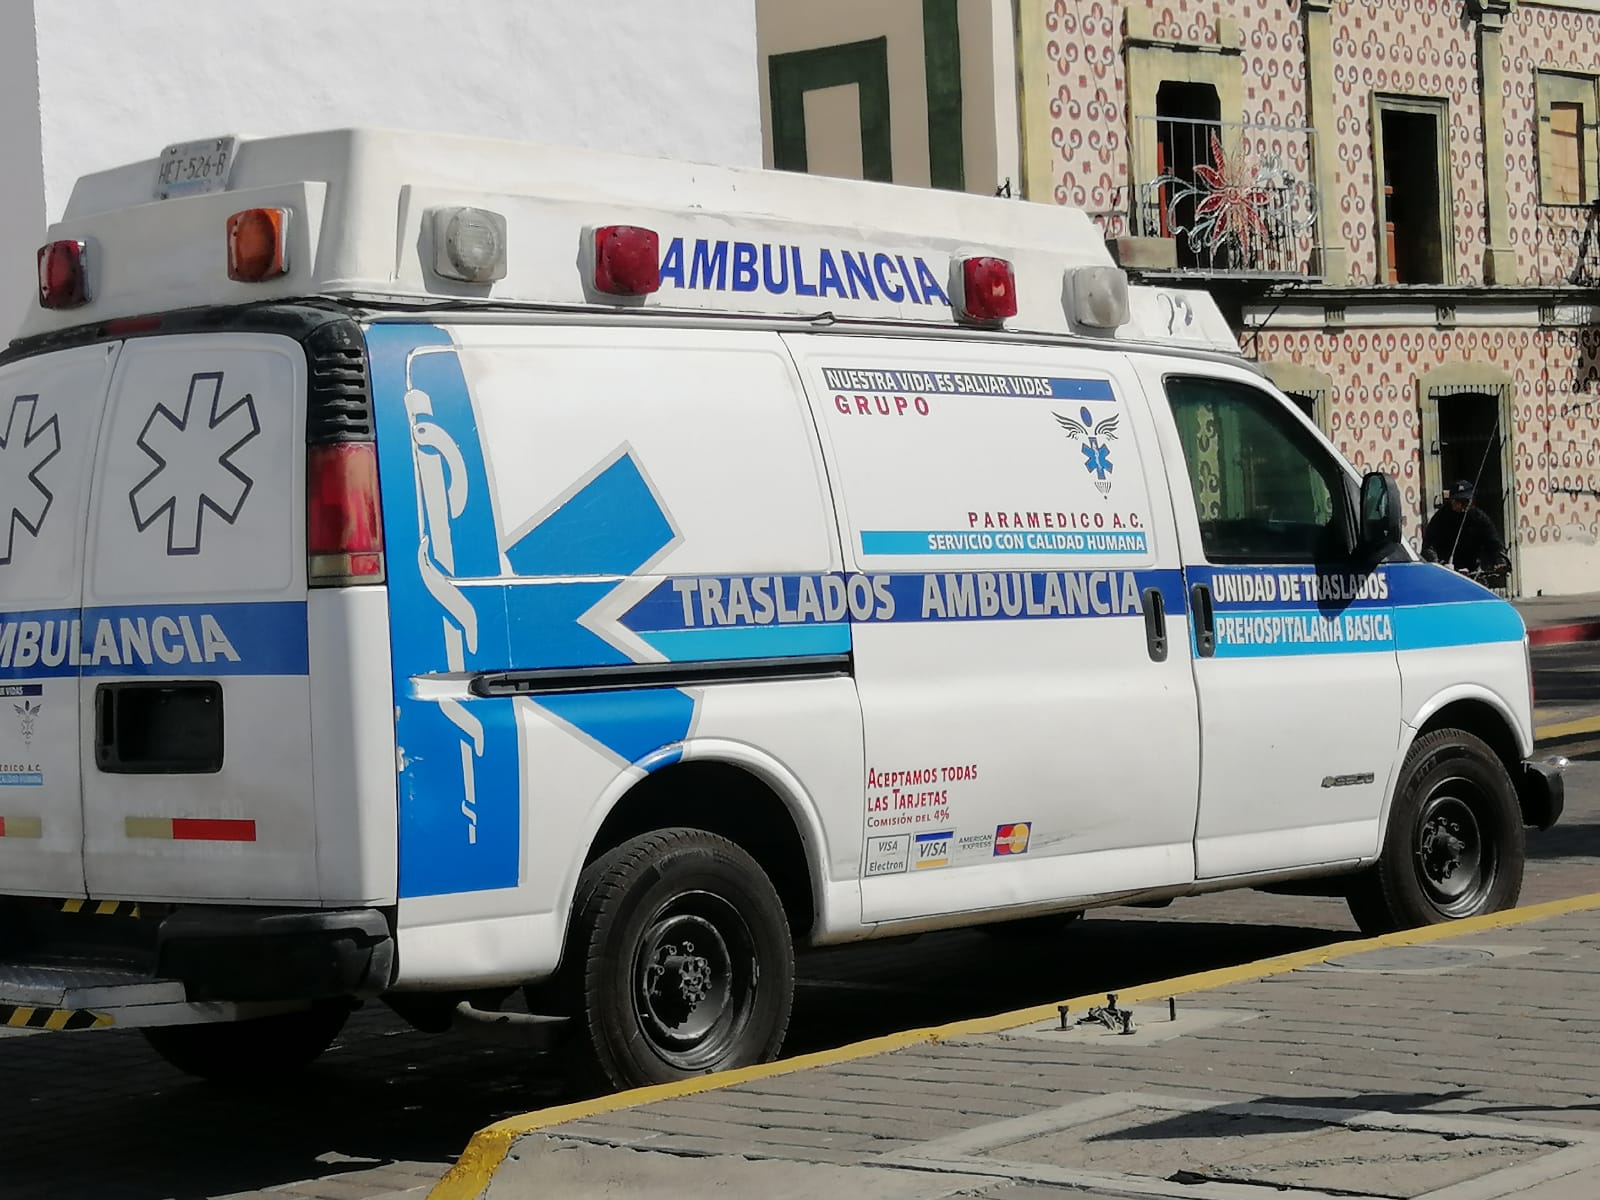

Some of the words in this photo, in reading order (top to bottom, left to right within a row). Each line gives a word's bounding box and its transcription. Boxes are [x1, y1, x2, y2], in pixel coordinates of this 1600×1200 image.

[659, 237, 949, 306] AMBULANCIA
[826, 370, 898, 390] NUESTRA
[896, 372, 936, 392] VIDA
[935, 374, 954, 392] ES
[953, 374, 1011, 394] SALVAR
[1008, 377, 1053, 396] VIDAS
[835, 395, 929, 416] GRUPO
[968, 512, 1104, 528] PARAMEDICO
[928, 534, 993, 550] SERVICIO
[995, 534, 1024, 549] CON
[1027, 534, 1084, 550] CALIDAD
[1086, 535, 1145, 550] HUMANA
[1212, 574, 1276, 602] UNIDAD
[1278, 574, 1300, 602] DE
[1301, 573, 1388, 601] TRASLADOS
[672, 575, 895, 626] TRASLADOS
[921, 572, 1143, 618] AMBULANCIA
[1215, 616, 1342, 644] PREHOSPITALARIA
[1345, 614, 1393, 641] BASICA
[867, 768, 937, 789] ACEPTAMOS
[941, 764, 978, 782] TODAS
[867, 797, 889, 812] LAS
[892, 789, 948, 810] TARJETAS
[915, 814, 931, 823] DEL
[934, 807, 950, 823] 4%
[878, 840, 898, 852] VISA
[958, 834, 992, 845] AMERICAN
[962, 841, 992, 850] EXPRESS
[919, 842, 947, 857] VISA
[869, 860, 904, 872] Electron
